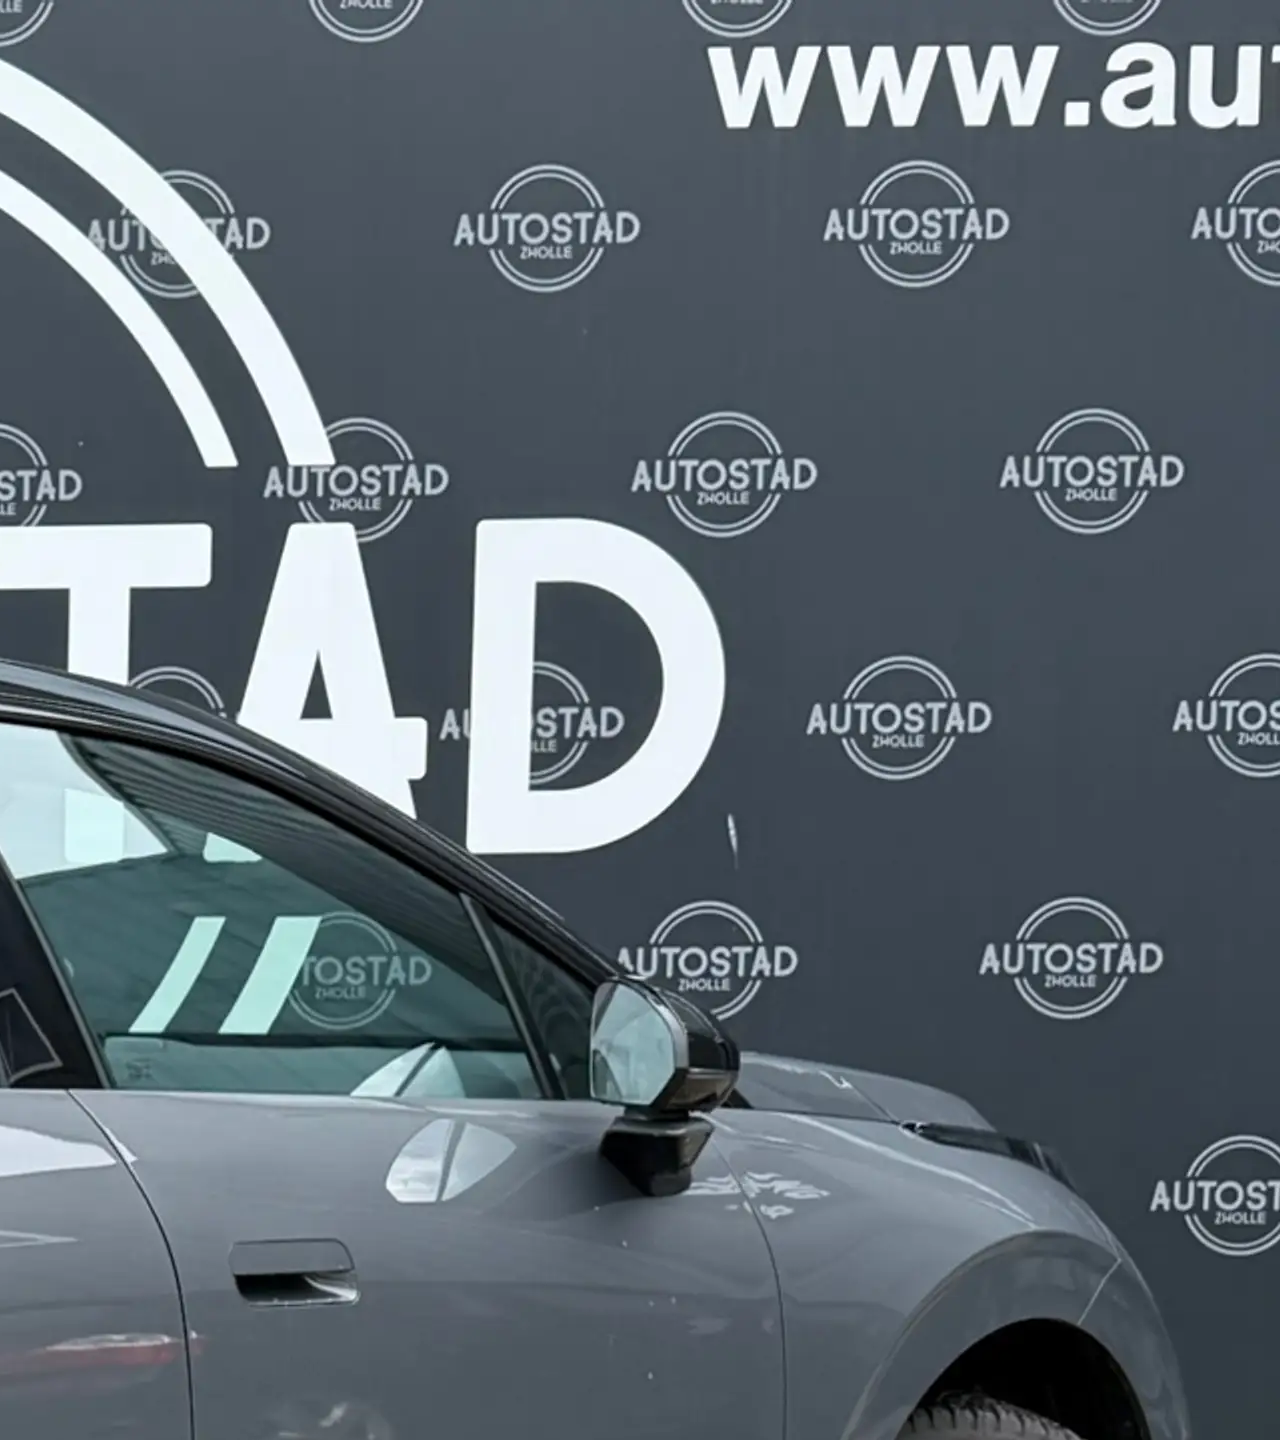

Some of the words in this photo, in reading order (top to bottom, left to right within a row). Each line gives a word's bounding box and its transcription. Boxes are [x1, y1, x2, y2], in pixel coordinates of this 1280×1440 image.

[707, 42, 1280, 129] www.au
[88, 217, 271, 251] AUTTAD
[453, 211, 641, 246] AUTOSTAD
[823, 208, 1010, 241] AUTOSTAD
[263, 464, 449, 498] AUTOSTAD
[631, 458, 818, 492] AUTOSTAD
[999, 455, 1185, 488] AUTOSTAD
[439, 706, 625, 740] ASTAD
[806, 701, 992, 735] AUTOSTAD
[302, 955, 432, 987] TOSTAD
[618, 946, 798, 978] AUTOSTAD
[979, 942, 1164, 975] AUTOSTAD
